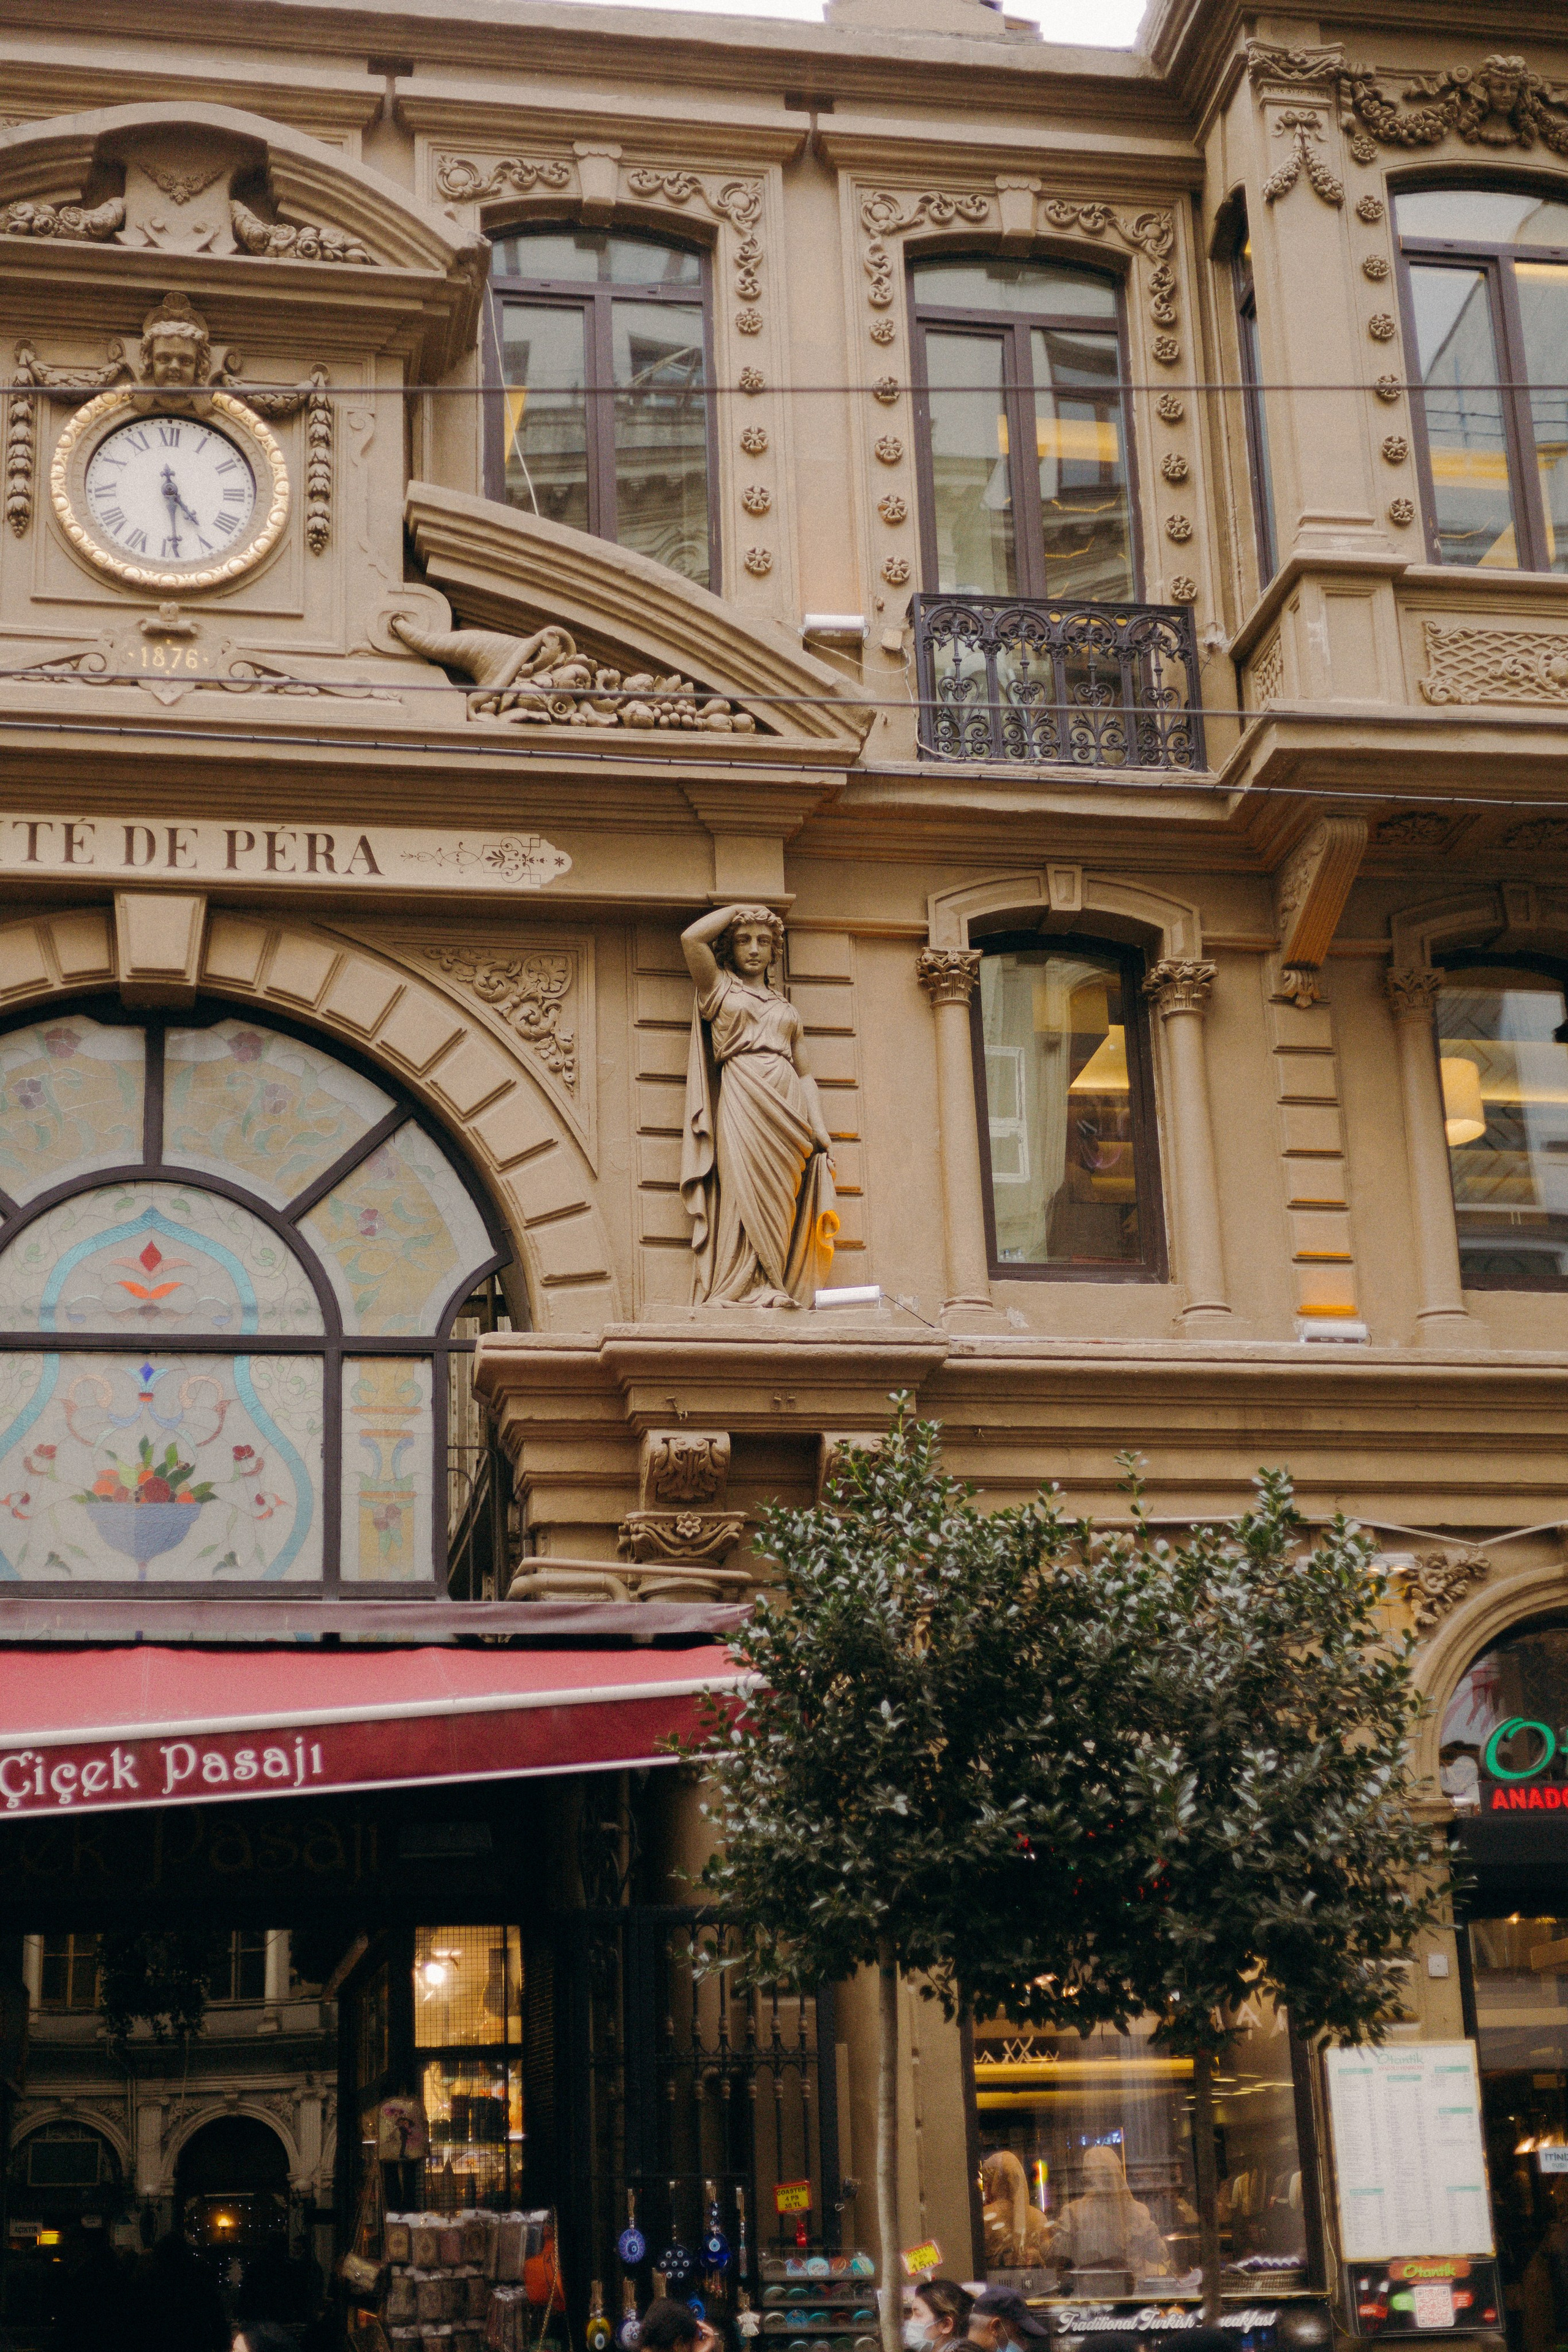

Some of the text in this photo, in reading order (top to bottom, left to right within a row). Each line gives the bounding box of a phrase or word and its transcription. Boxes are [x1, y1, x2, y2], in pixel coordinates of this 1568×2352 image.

[140, 646, 198, 669] 1876
[0, 818, 386, 876] TÉ DE PÉRA
[1486, 1717, 1568, 1779] O
[0, 1736, 322, 1809] Çiçek Pasajı
[1377, 2052, 1424, 2065] Otantik
[777, 2186, 806, 2196] COASTER
[906, 2244, 933, 2258] OASTER
[1403, 2264, 1457, 2278] Otantik
[1058, 2308, 1276, 2334] Traditional Turkish reakfast
